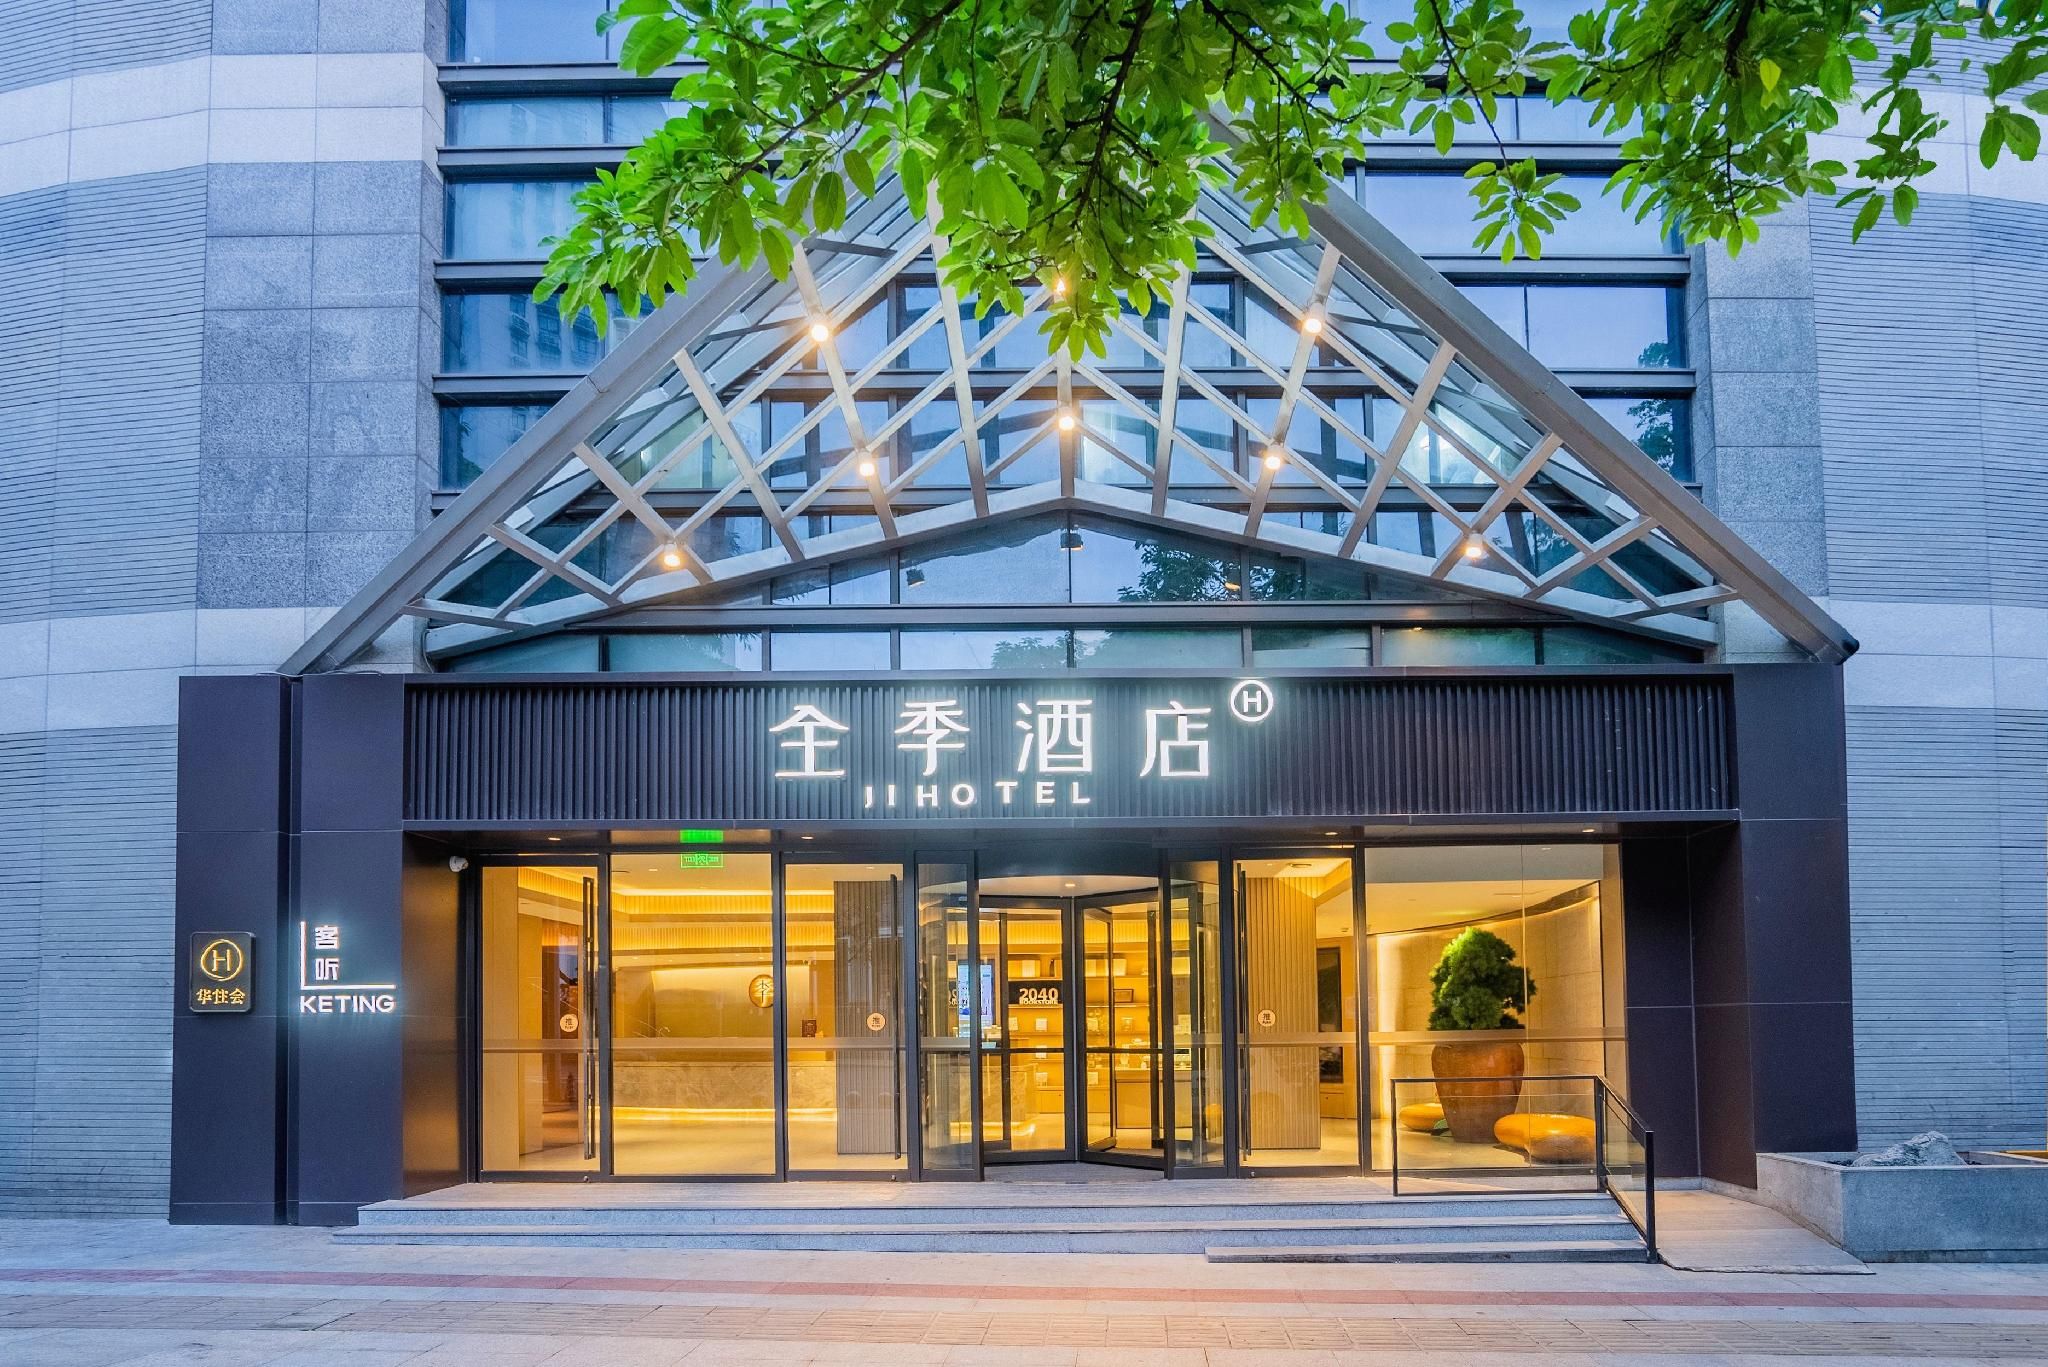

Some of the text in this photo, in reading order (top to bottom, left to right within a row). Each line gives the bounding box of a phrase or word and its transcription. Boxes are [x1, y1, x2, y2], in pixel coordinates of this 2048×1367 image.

[769, 699, 1211, 778] 全季酒店
[314, 925, 339, 981] 客听
[196, 988, 246, 1006] 华住会
[1019, 987, 1059, 1000] 2040
[300, 995, 395, 1014] KETING
